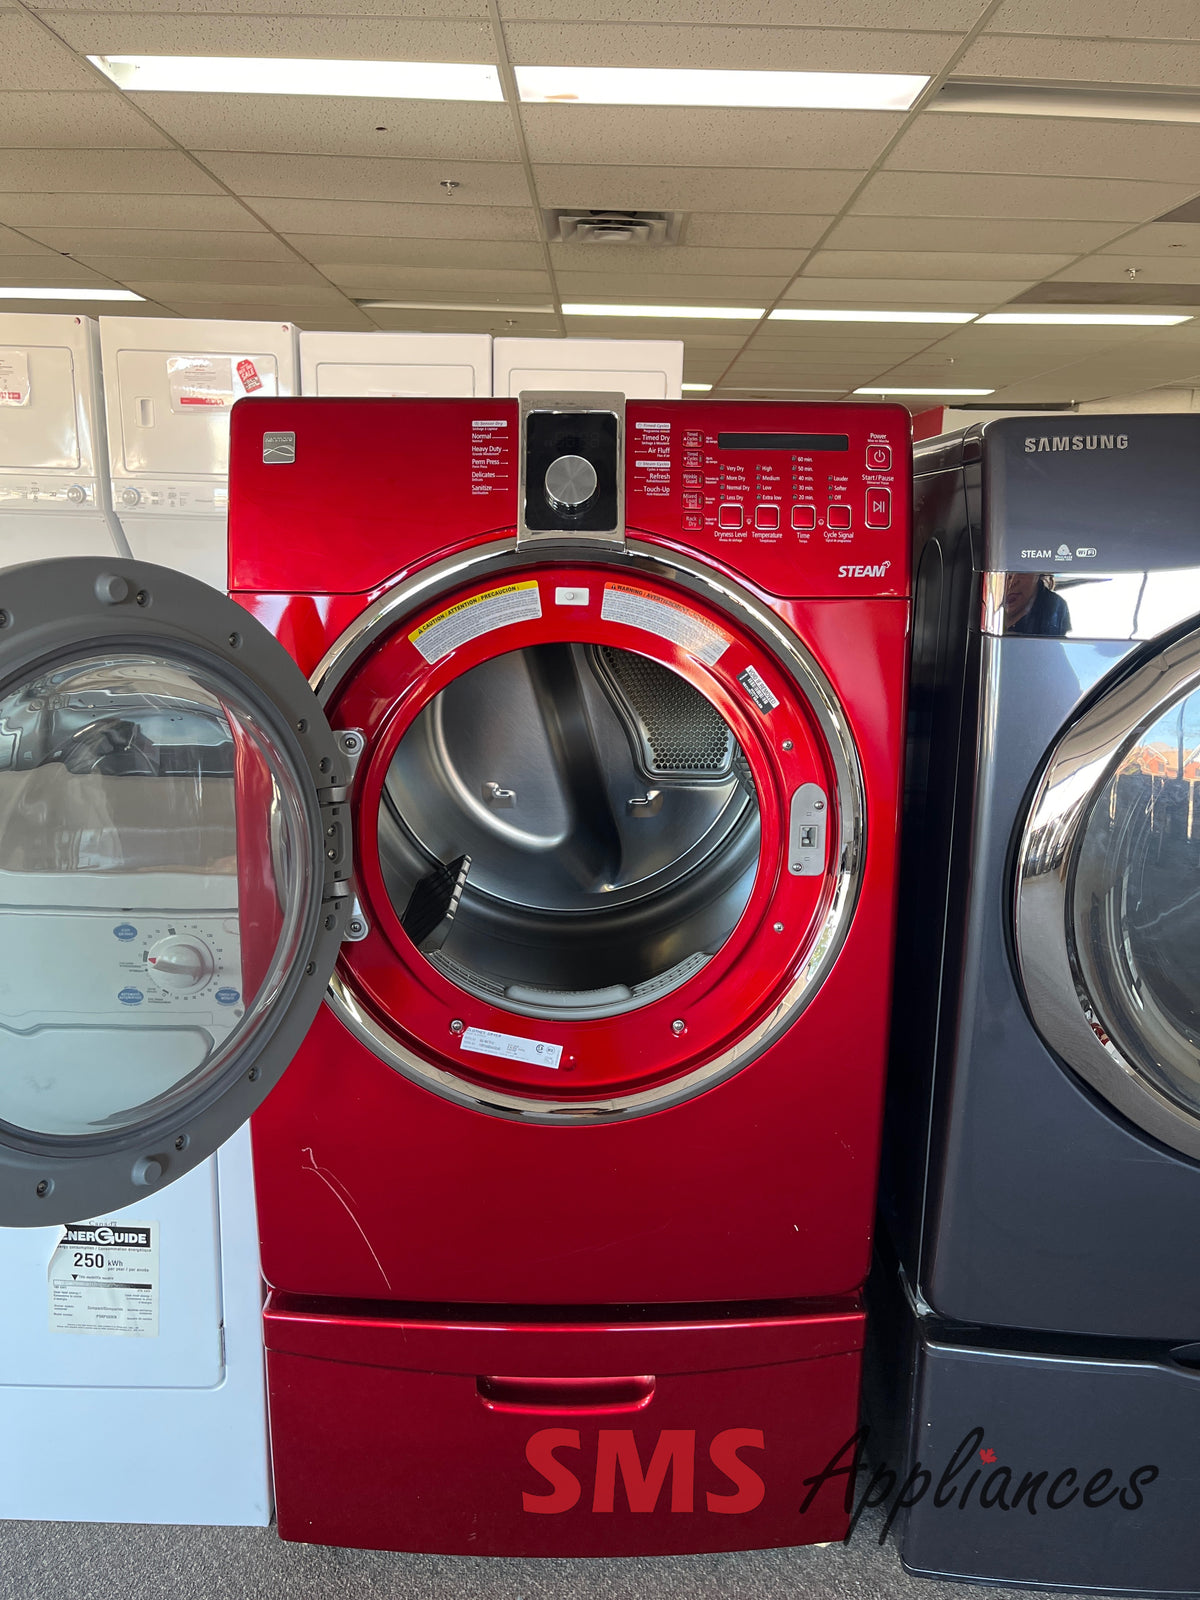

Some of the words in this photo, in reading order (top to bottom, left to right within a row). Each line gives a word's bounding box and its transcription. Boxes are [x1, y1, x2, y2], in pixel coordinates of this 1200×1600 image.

[1024, 435, 1128, 452] SAMSUNG
[1021, 550, 1052, 558] STEAM
[838, 566, 886, 577] STEAM
[617, 585, 643, 595] WARNING
[422, 614, 444, 630] CAUTION
[448, 599, 477, 615] ATTENTION
[759, 683, 776, 704] REMOVED
[74, 1252, 104, 1268] 250
